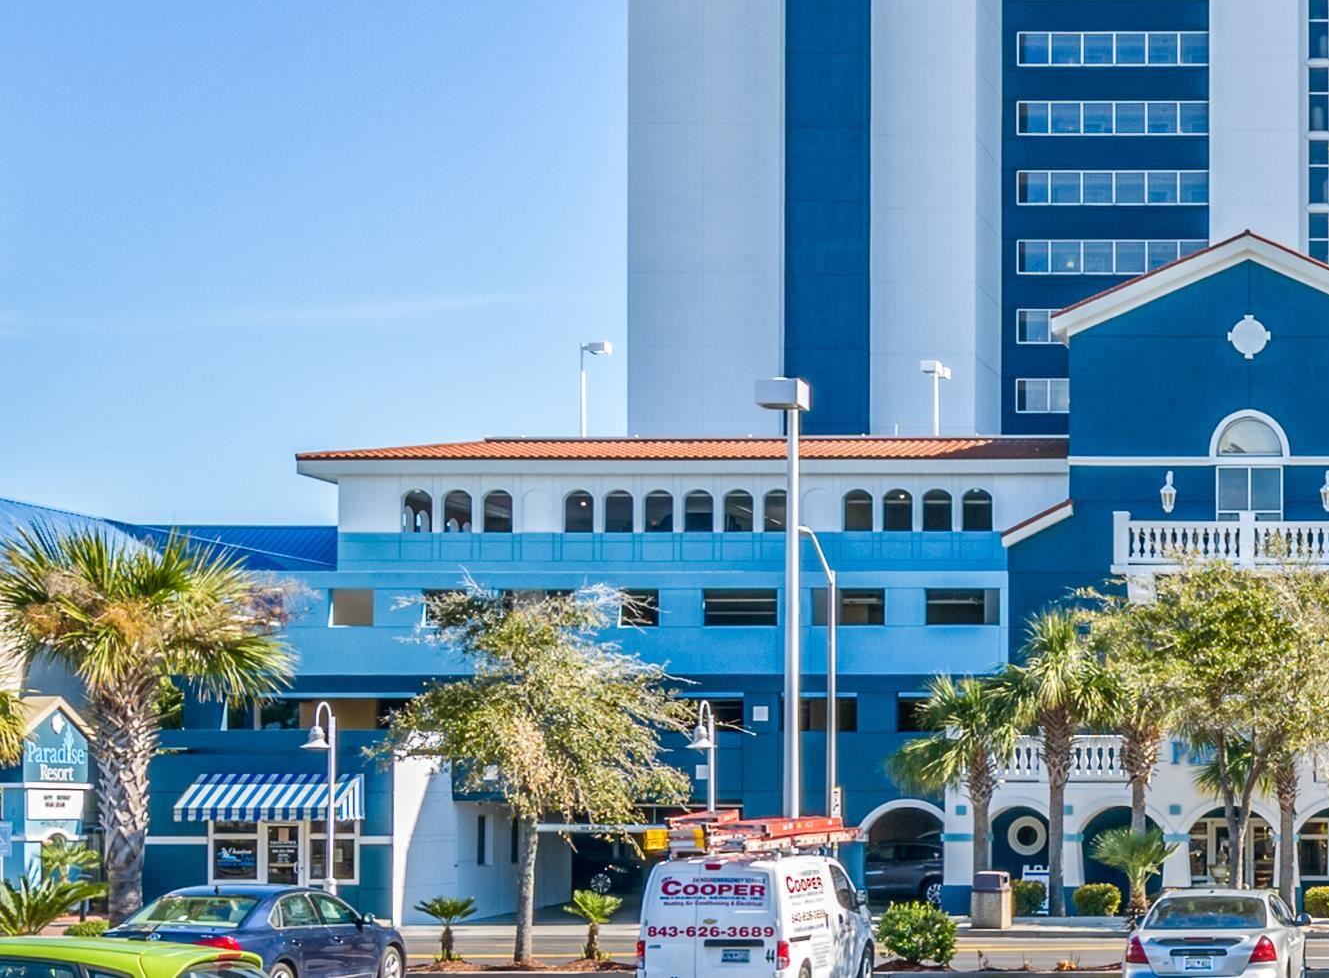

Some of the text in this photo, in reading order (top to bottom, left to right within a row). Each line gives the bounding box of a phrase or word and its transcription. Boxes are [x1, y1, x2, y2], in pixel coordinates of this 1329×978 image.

[27, 740, 85, 764] Paradise
[40, 764, 74, 781] Resort
[661, 880, 766, 896] COOPER
[647, 926, 775, 937] 843-626-3689
[765, 949, 775, 963] 44
